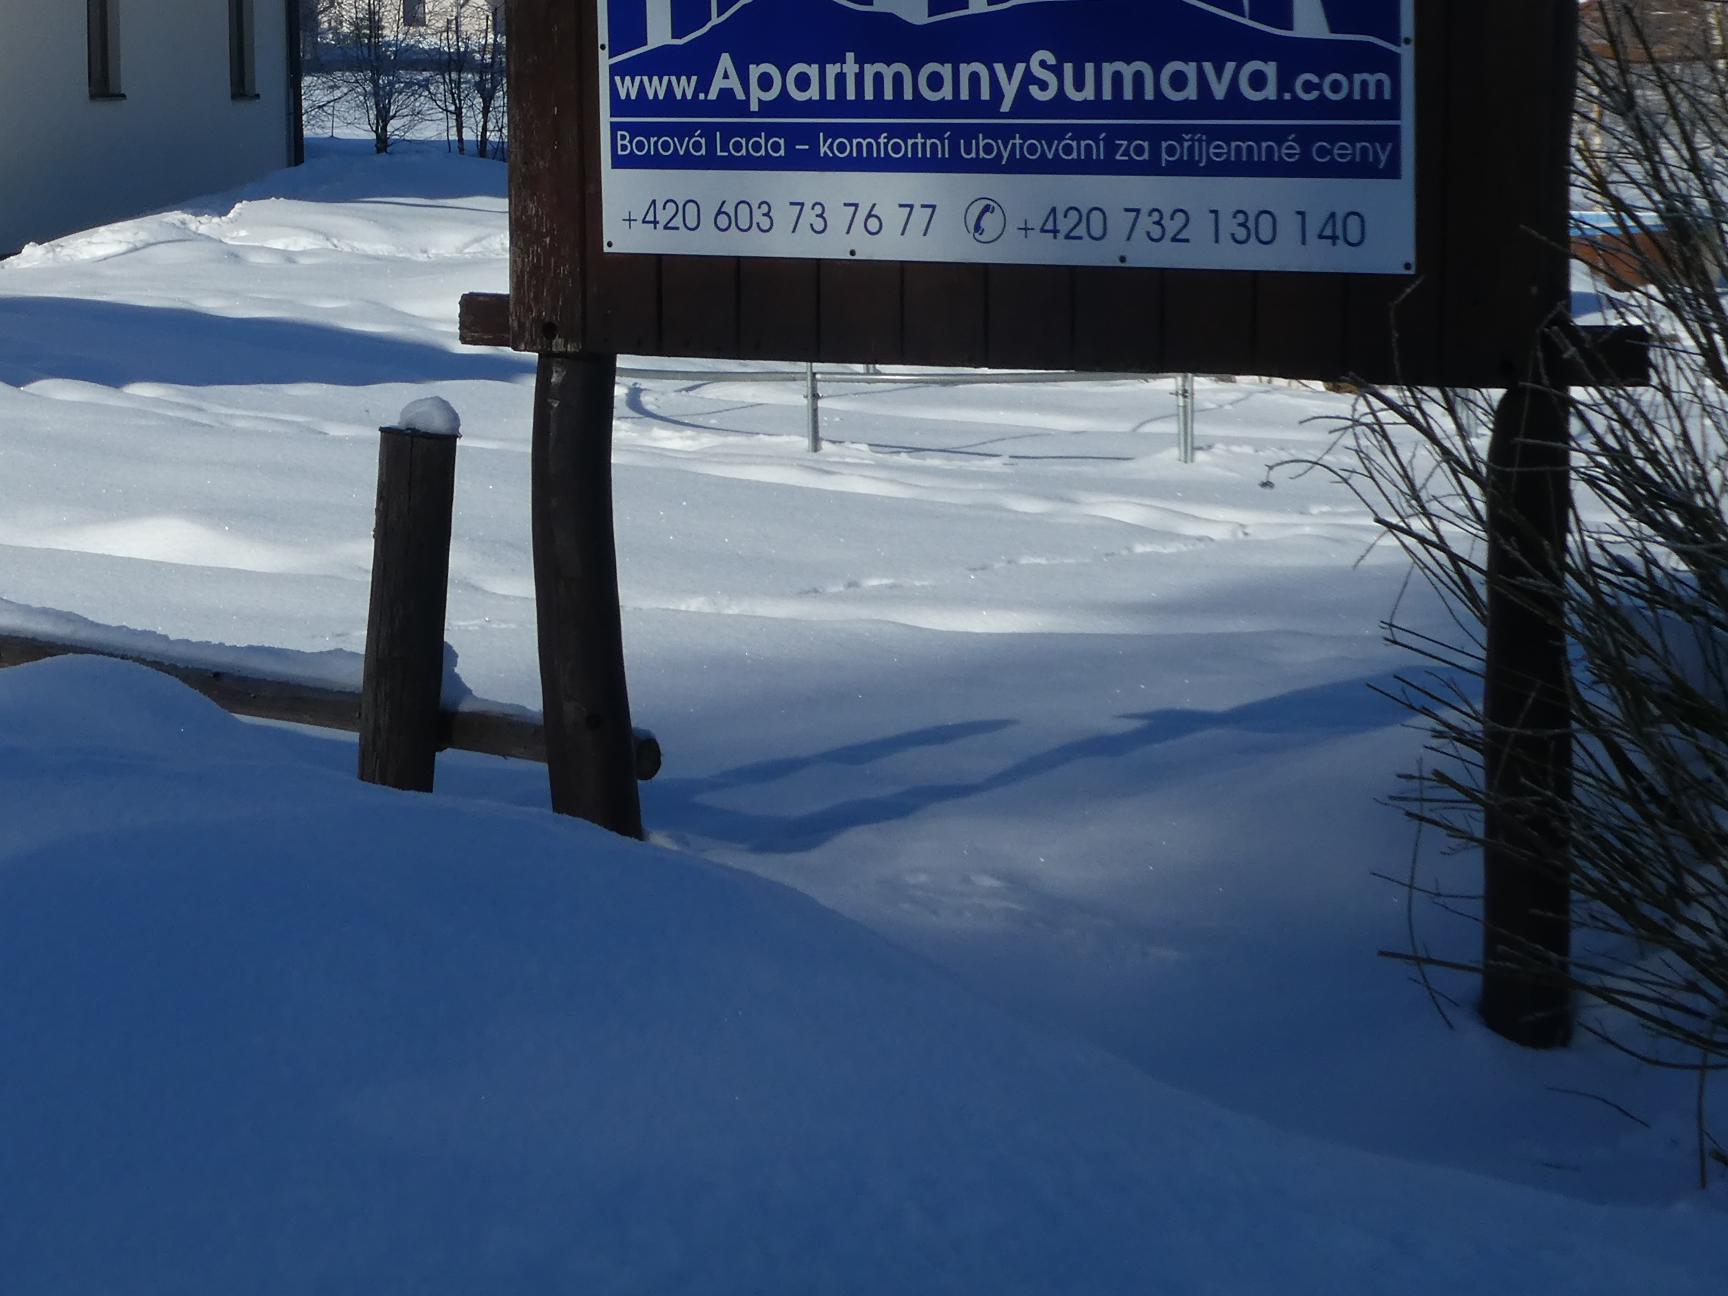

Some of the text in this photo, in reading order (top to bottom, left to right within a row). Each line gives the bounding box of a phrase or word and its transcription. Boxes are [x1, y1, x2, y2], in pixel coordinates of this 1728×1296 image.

[613, 48, 1393, 113] www.ApartmanySumava.com
[616, 129, 707, 157] Borová
[715, 131, 786, 158] Lada
[818, 131, 951, 160] komfortní
[959, 132, 1107, 165] ubytování
[1114, 139, 1150, 161] za
[1160, 133, 1302, 167] příjemné
[1311, 140, 1393, 169] ceny
[621, 198, 1367, 248] +420 603 73 76 77 +420 732 130 140
